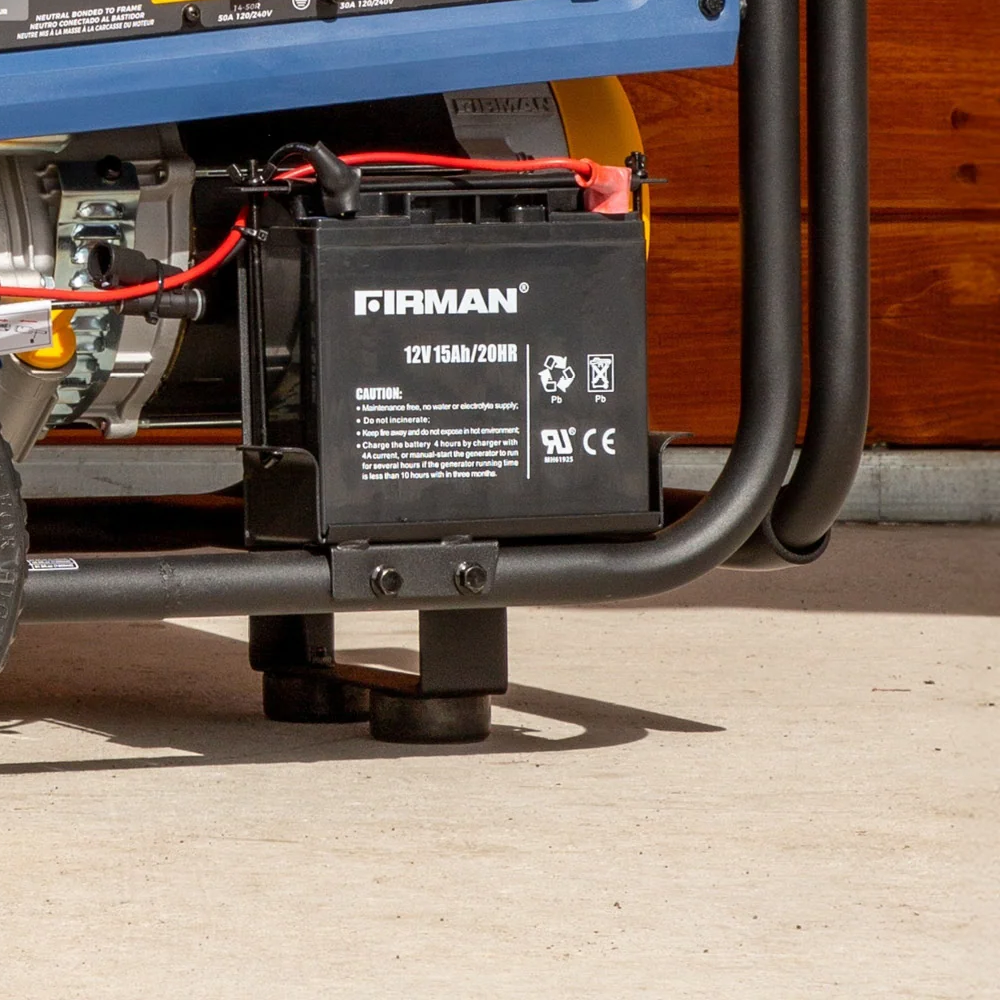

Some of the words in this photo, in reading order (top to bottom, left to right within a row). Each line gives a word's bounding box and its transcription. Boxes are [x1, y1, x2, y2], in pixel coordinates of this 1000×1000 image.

[233, 3, 261, 12] 14-50R
[340, 1, 355, 10] 30A
[35, 12, 69, 21] NEUTRAL
[72, 9, 103, 18] BONDED
[117, 4, 142, 13] FRAME
[218, 13, 234, 22] 50A
[236, 10, 273, 20] 120/240V
[30, 21, 57, 30] NEUTRO
[59, 17, 100, 27] CONECTADO
[111, 12, 145, 21] BASTIDOR
[17, 31, 38, 40] NEUTRE
[404, 345, 431, 364] 12V
[433, 343, 518, 363] 15Ah/20HR
[356, 387, 402, 400] CAUTION:
[551, 395, 563, 404] Pb
[595, 394, 606, 403] Pb
[362, 404, 405, 412] Maintenance
[390, 416, 430, 424] incinerate;
[362, 429, 379, 438] Keep
[440, 428, 463, 436] expose
[362, 441, 390, 450] Charge
[405, 441, 431, 449] battery
[462, 440, 471, 448] by
[473, 440, 501, 448] charger
[583, 428, 616, 455] CE
[465, 450, 499, 459] generator
[400, 461, 420, 469] hours
[440, 460, 475, 469] generator
[475, 460, 502, 468] running
[369, 472, 383, 480] less
